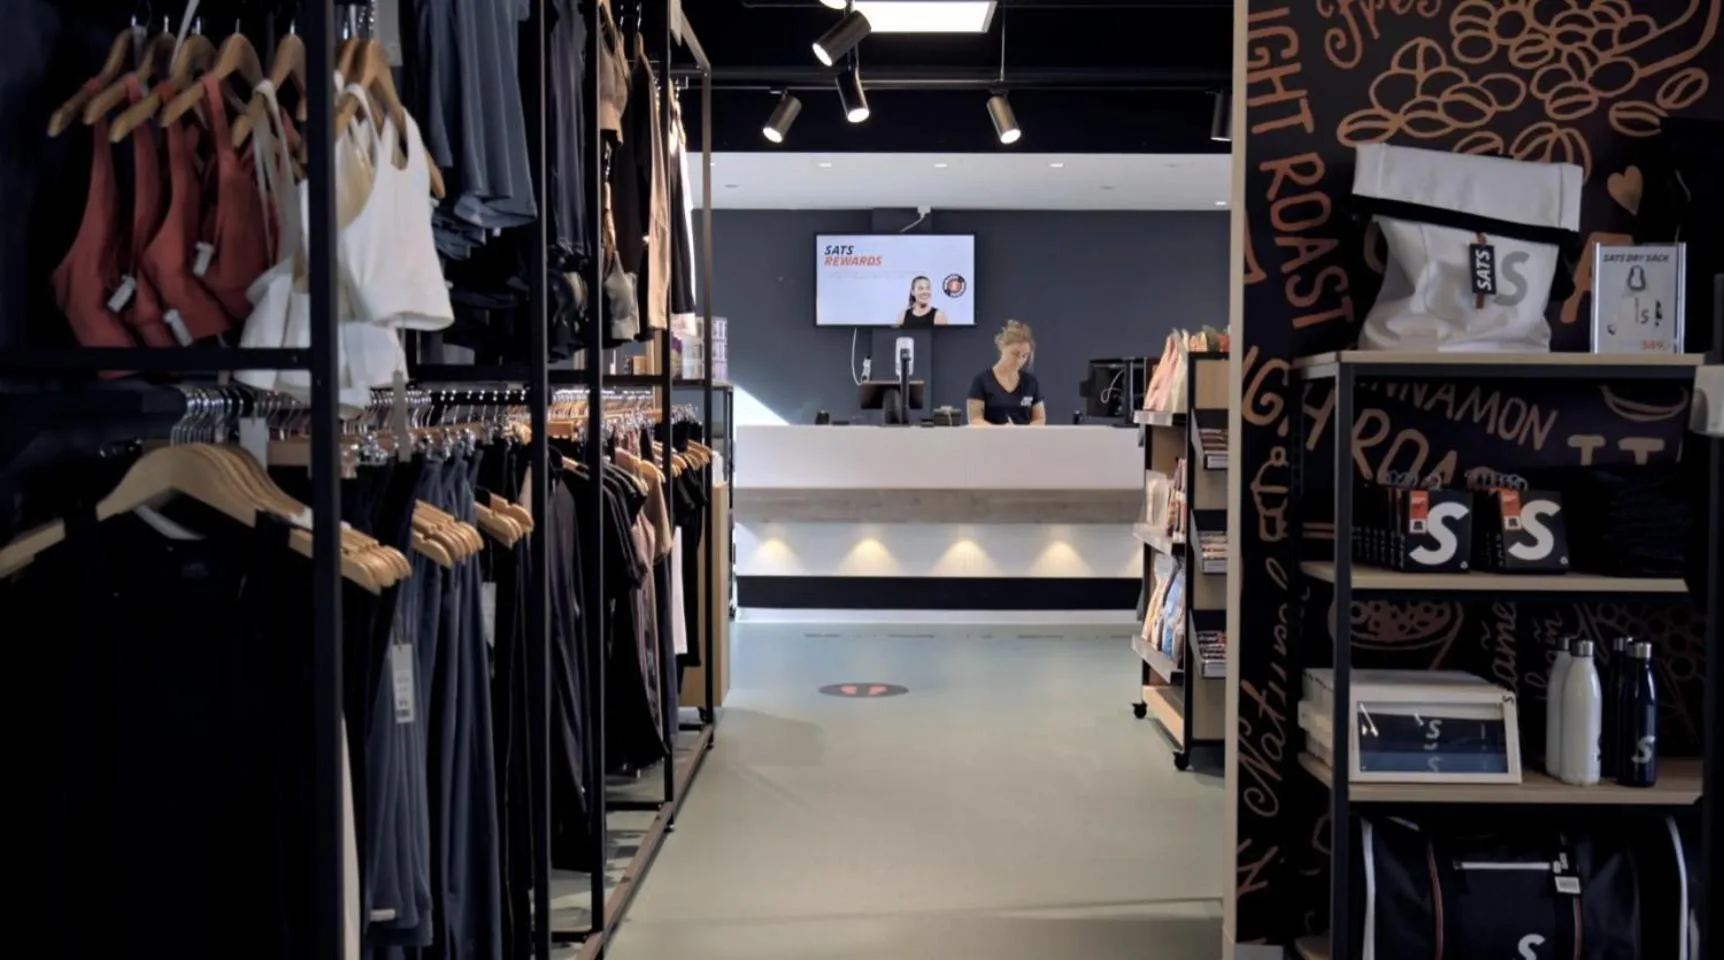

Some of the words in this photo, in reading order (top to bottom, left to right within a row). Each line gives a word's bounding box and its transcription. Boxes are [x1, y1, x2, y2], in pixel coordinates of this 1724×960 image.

[823, 245, 855, 255] SATS
[823, 256, 883, 267] REWARDS
[1259, 152, 1354, 330] ROAST
[1475, 248, 1492, 292] SATS
[1408, 501, 1470, 565] S
[1507, 498, 1562, 561] S
